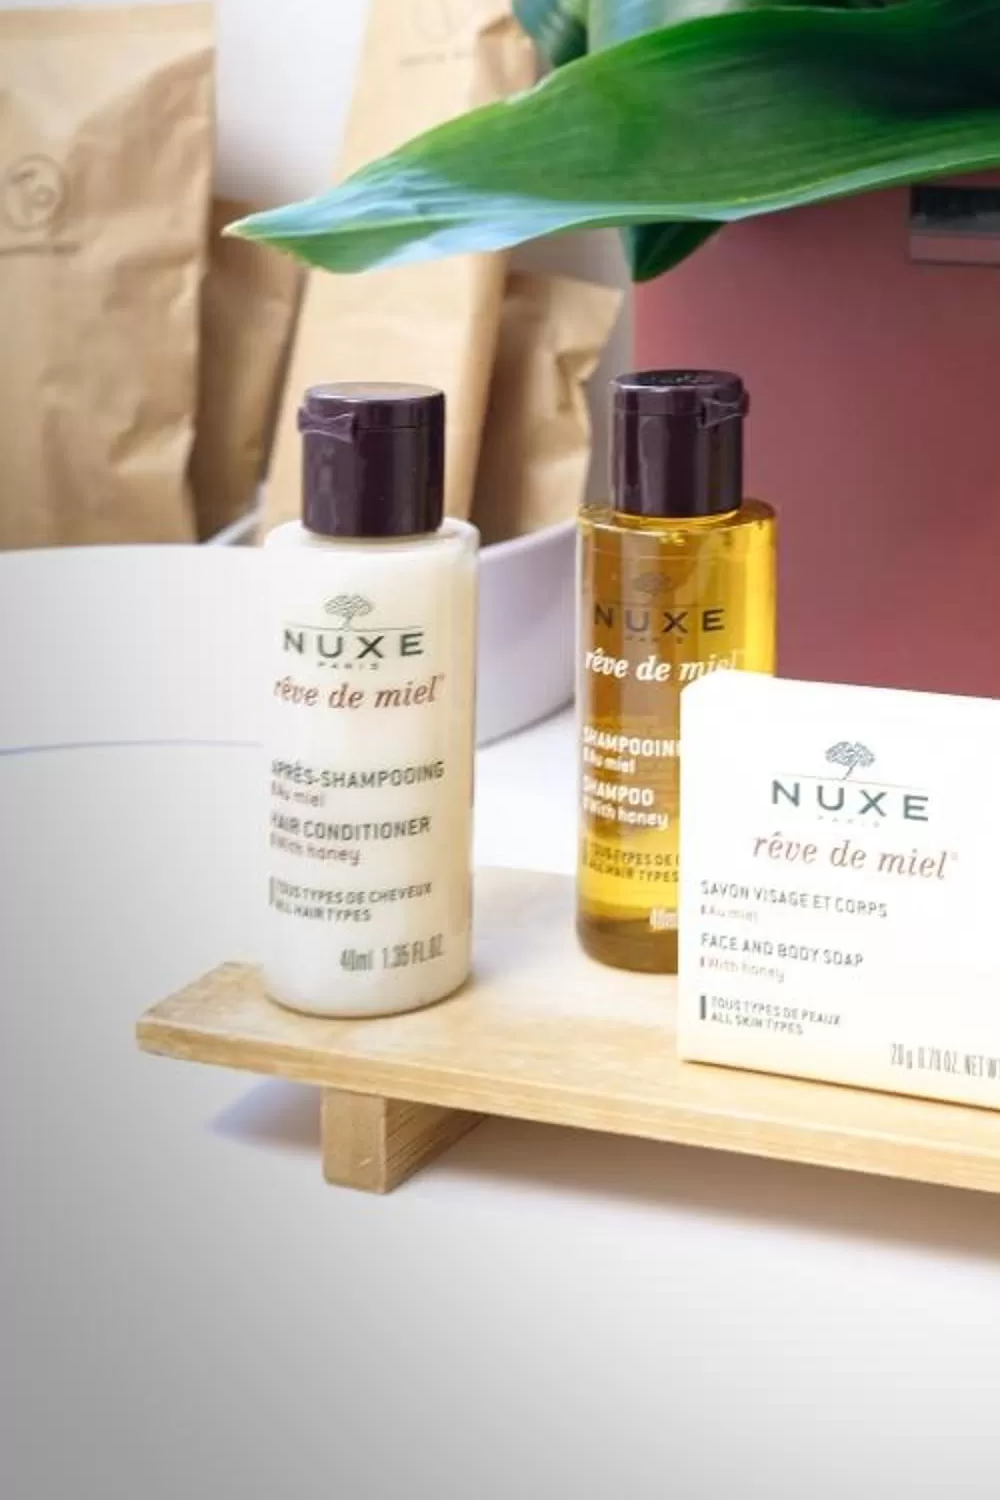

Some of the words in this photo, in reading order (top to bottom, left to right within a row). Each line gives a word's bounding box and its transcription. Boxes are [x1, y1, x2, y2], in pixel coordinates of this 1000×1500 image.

[594, 604, 725, 634] NUXE
[283, 630, 424, 659] NUXE
[585, 647, 629, 678] rêve
[636, 655, 672, 681] de
[274, 675, 318, 706] rêve
[328, 683, 364, 709] de
[374, 674, 438, 709] miel
[771, 779, 928, 822] NUXE
[304, 816, 432, 841] CONDITIONER
[618, 806, 668, 830] honey
[753, 831, 818, 864] rêve
[830, 839, 868, 869] de
[877, 848, 948, 880] miel
[303, 888, 342, 904] TYPES
[346, 892, 365, 905] DE
[368, 882, 432, 903] CHEVEUX
[700, 879, 749, 900] SAVON
[754, 886, 809, 908] VISAGE
[813, 895, 832, 911] ET
[835, 898, 888, 918] CORPS
[328, 908, 371, 922] TYPES
[700, 932, 737, 951] FACE
[742, 939, 773, 956] AND
[778, 943, 819, 962] BODY
[824, 949, 864, 967] SOAP
[744, 1001, 781, 1017] TYPES
[802, 1009, 840, 1026] PEAUX
[767, 1018, 804, 1035] TYPES
